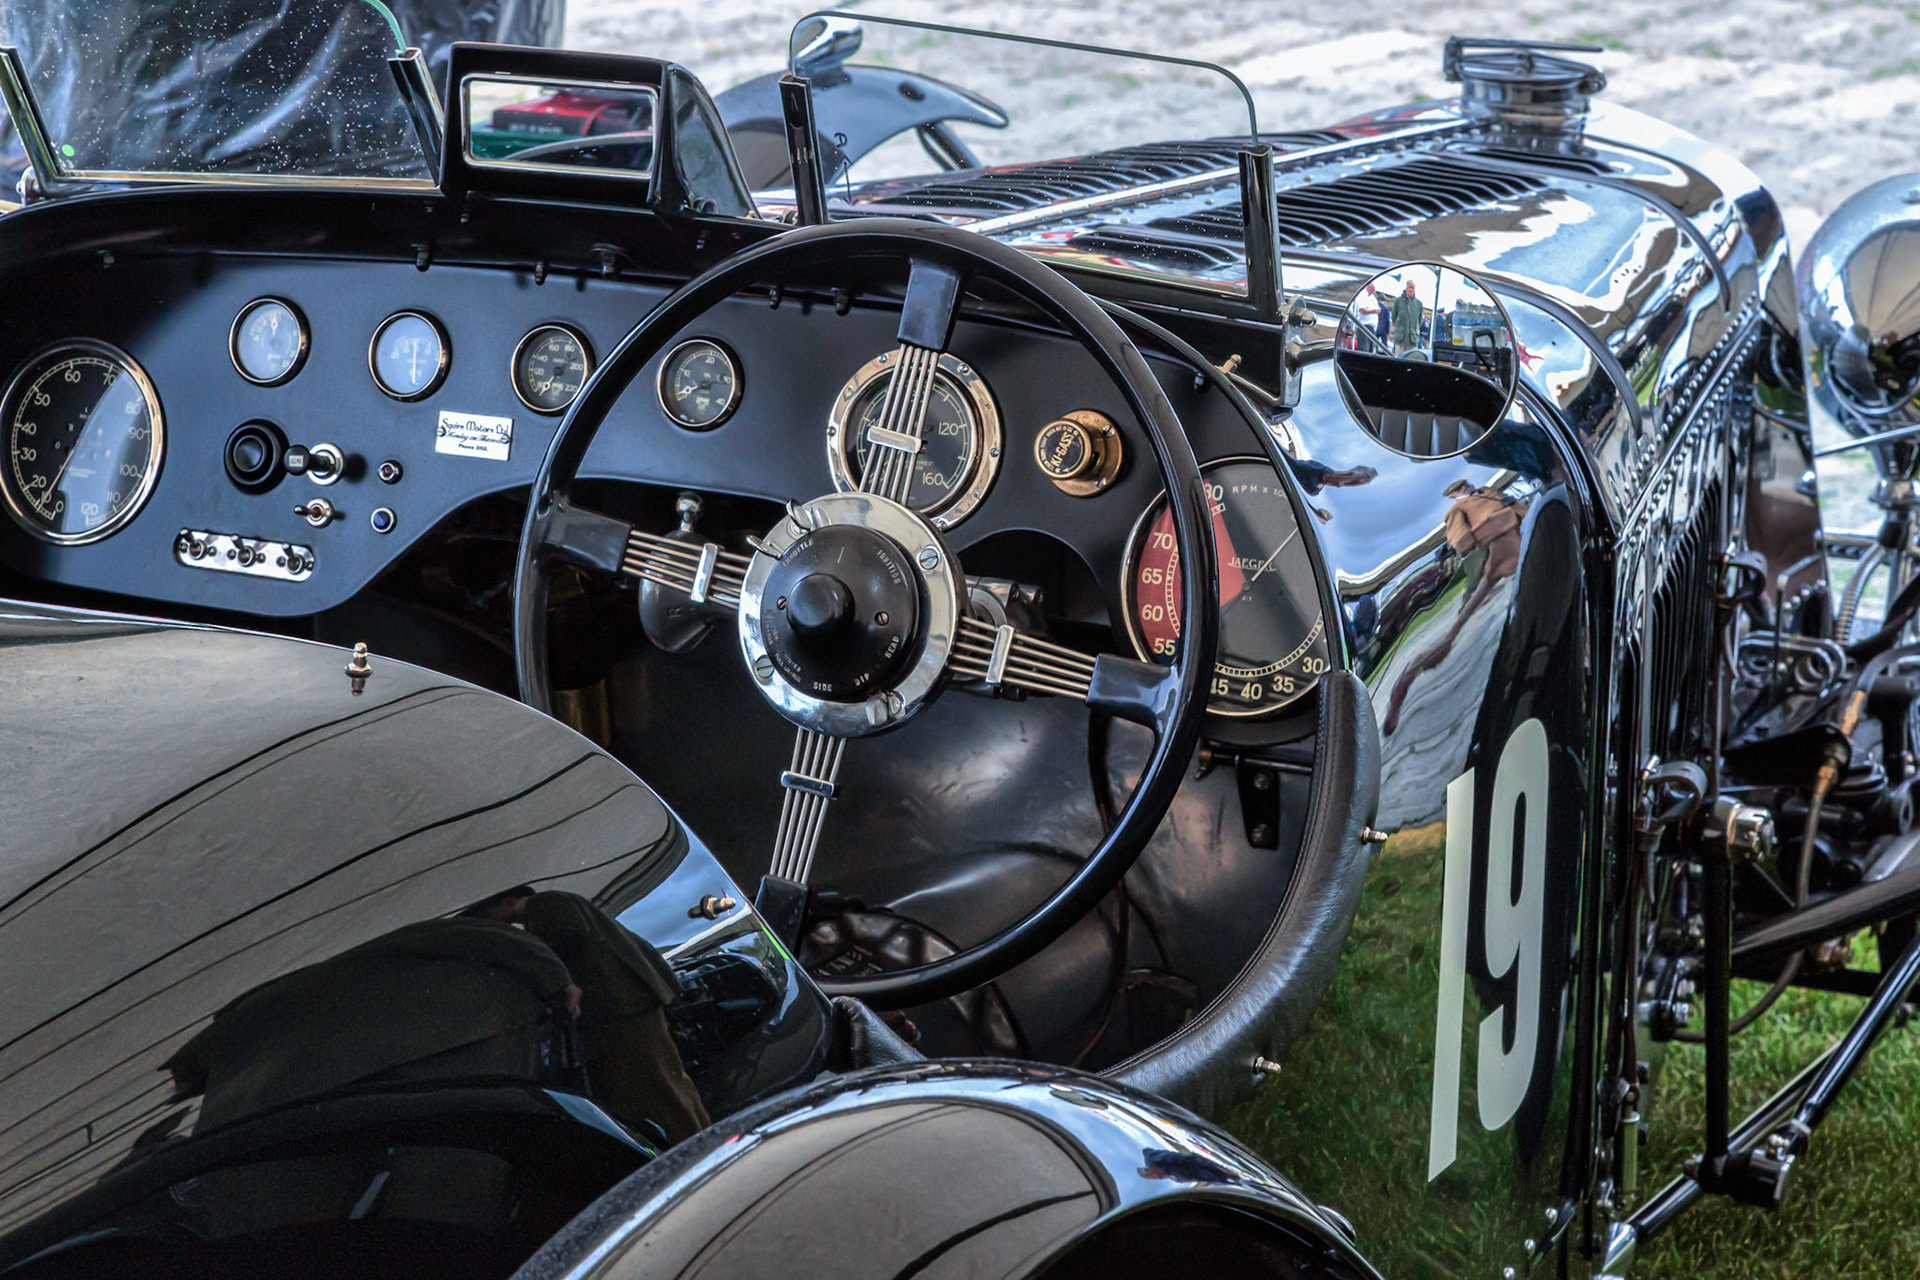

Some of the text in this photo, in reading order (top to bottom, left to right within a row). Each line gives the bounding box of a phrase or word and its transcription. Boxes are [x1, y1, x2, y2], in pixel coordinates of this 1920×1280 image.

[569, 362, 584, 371] 200
[705, 356, 716, 364] 20
[64, 370, 81, 383] 60
[102, 373, 117, 386] 70
[564, 383, 579, 392] 220
[34, 393, 51, 406] 50
[125, 403, 141, 415] 80
[21, 423, 37, 435] 40
[442, 417, 509, 435] Squire Motors Ltd
[938, 422, 959, 436] 120
[129, 427, 144, 440] 90
[20, 448, 36, 461] 30
[1050, 431, 1074, 467] KI-GASS
[119, 464, 138, 477] 100
[30, 474, 47, 488] 20
[922, 472, 944, 486] 160
[106, 491, 120, 503] 110
[1231, 485, 1258, 495] RPM
[55, 501, 64, 512] 0
[81, 502, 99, 515] 120
[1152, 531, 1173, 550] 70
[781, 538, 815, 567] THROTTLE
[877, 550, 901, 585] IGNITION
[1141, 568, 1163, 585] 65
[1141, 604, 1164, 622] 60
[884, 636, 900, 659] HEAD
[1153, 637, 1176, 656] 55
[1302, 657, 1324, 675] 30
[813, 681, 833, 692] SIDE
[854, 672, 870, 687] DIP
[1210, 678, 1229, 695] 45
[1272, 675, 1294, 694] 35
[1241, 683, 1262, 700] 40
[1427, 717, 1549, 1183] 19
